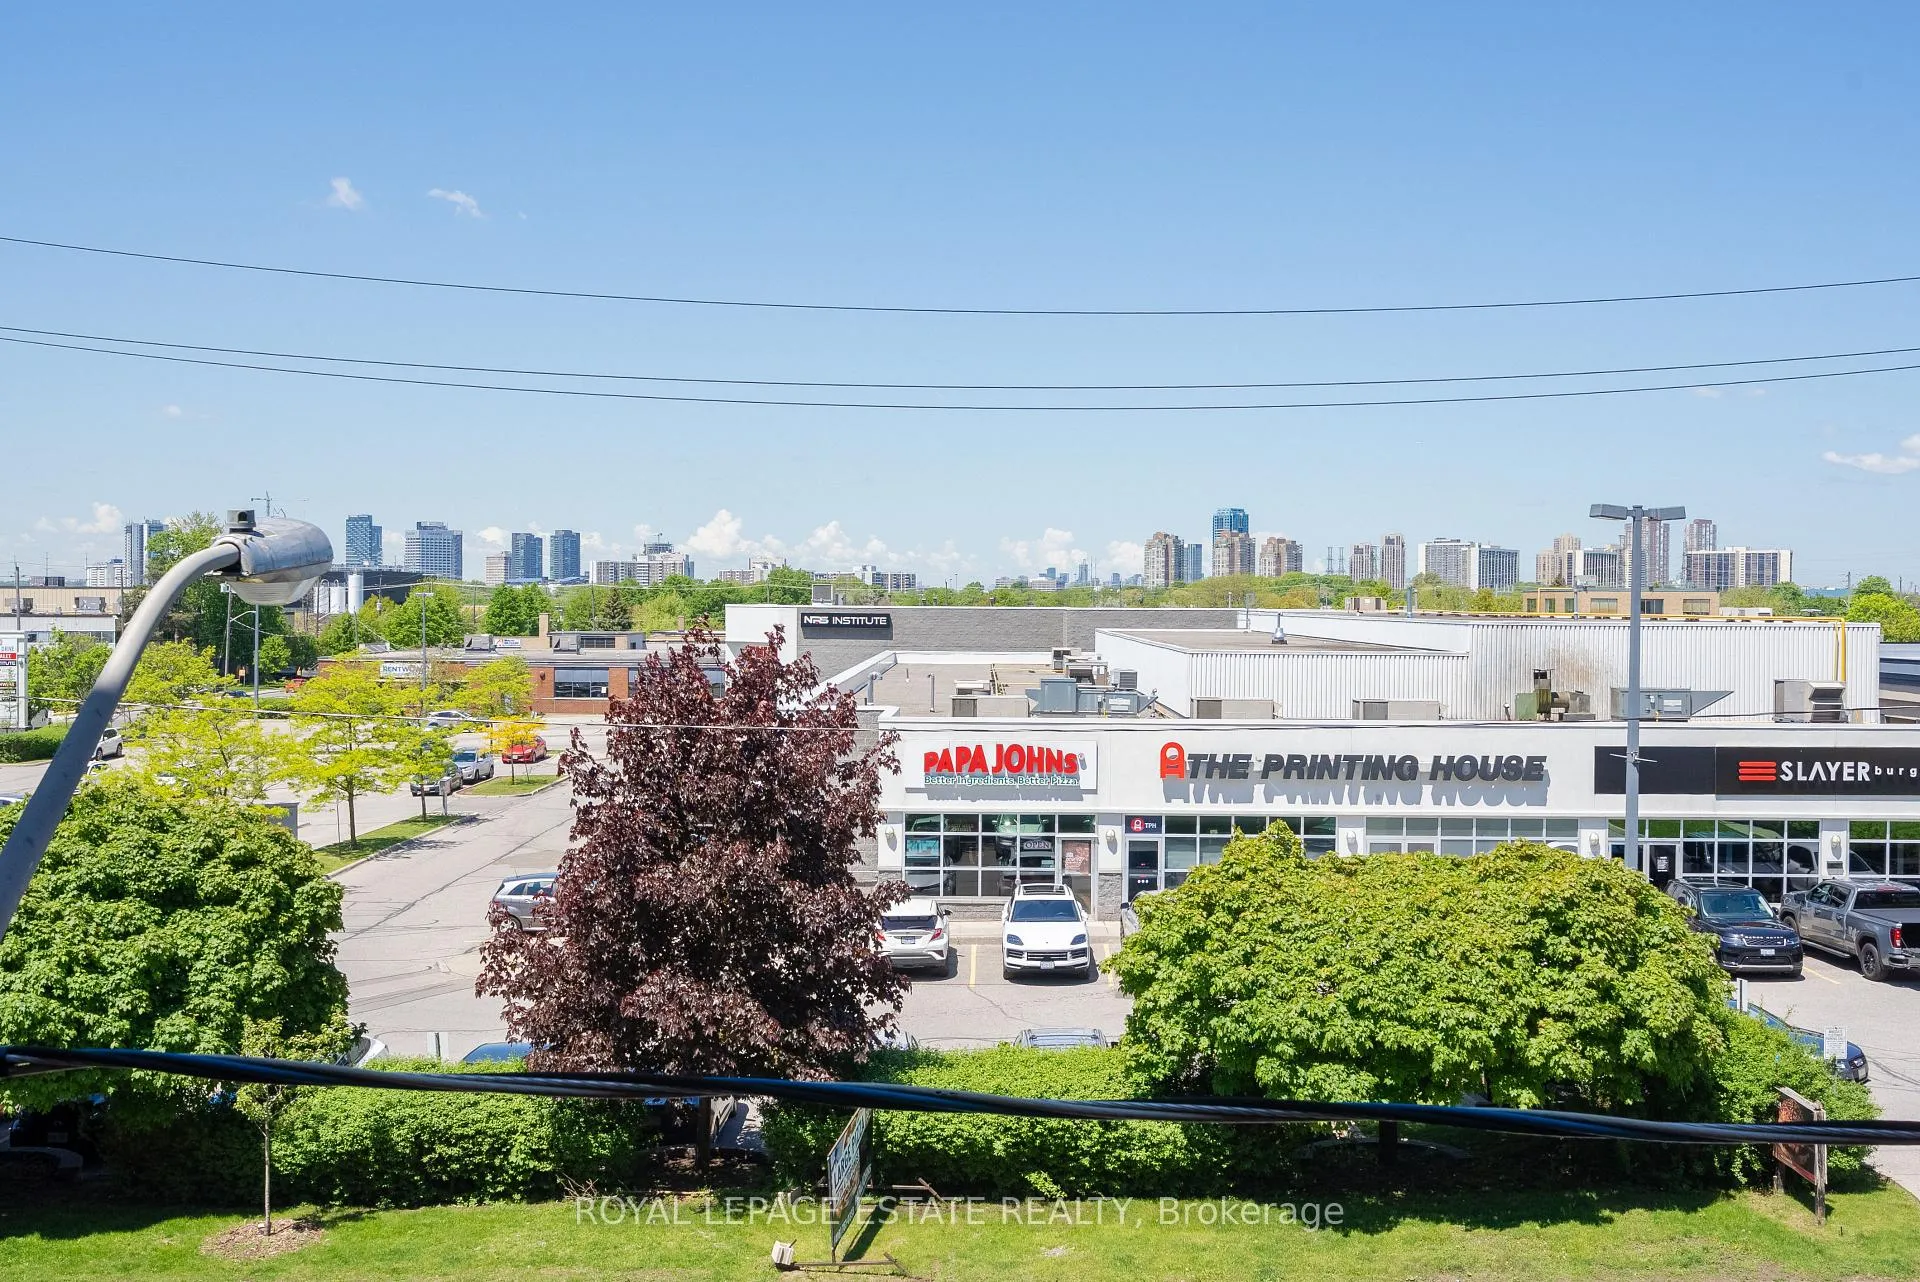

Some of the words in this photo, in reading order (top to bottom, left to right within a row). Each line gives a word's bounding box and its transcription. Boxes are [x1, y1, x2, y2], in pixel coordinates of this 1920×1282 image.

[832, 616, 887, 625] INSTITUTE
[924, 744, 989, 773] PAPA
[992, 743, 1079, 774] JOHNS
[1188, 754, 1252, 780] THE
[1261, 754, 1419, 781] PRINTING
[1429, 755, 1547, 782] HOUSE
[1780, 761, 1870, 781] SLAYER
[924, 776, 955, 785] Better
[1018, 776, 1049, 785] Better
[1025, 840, 1050, 849] OPEN
